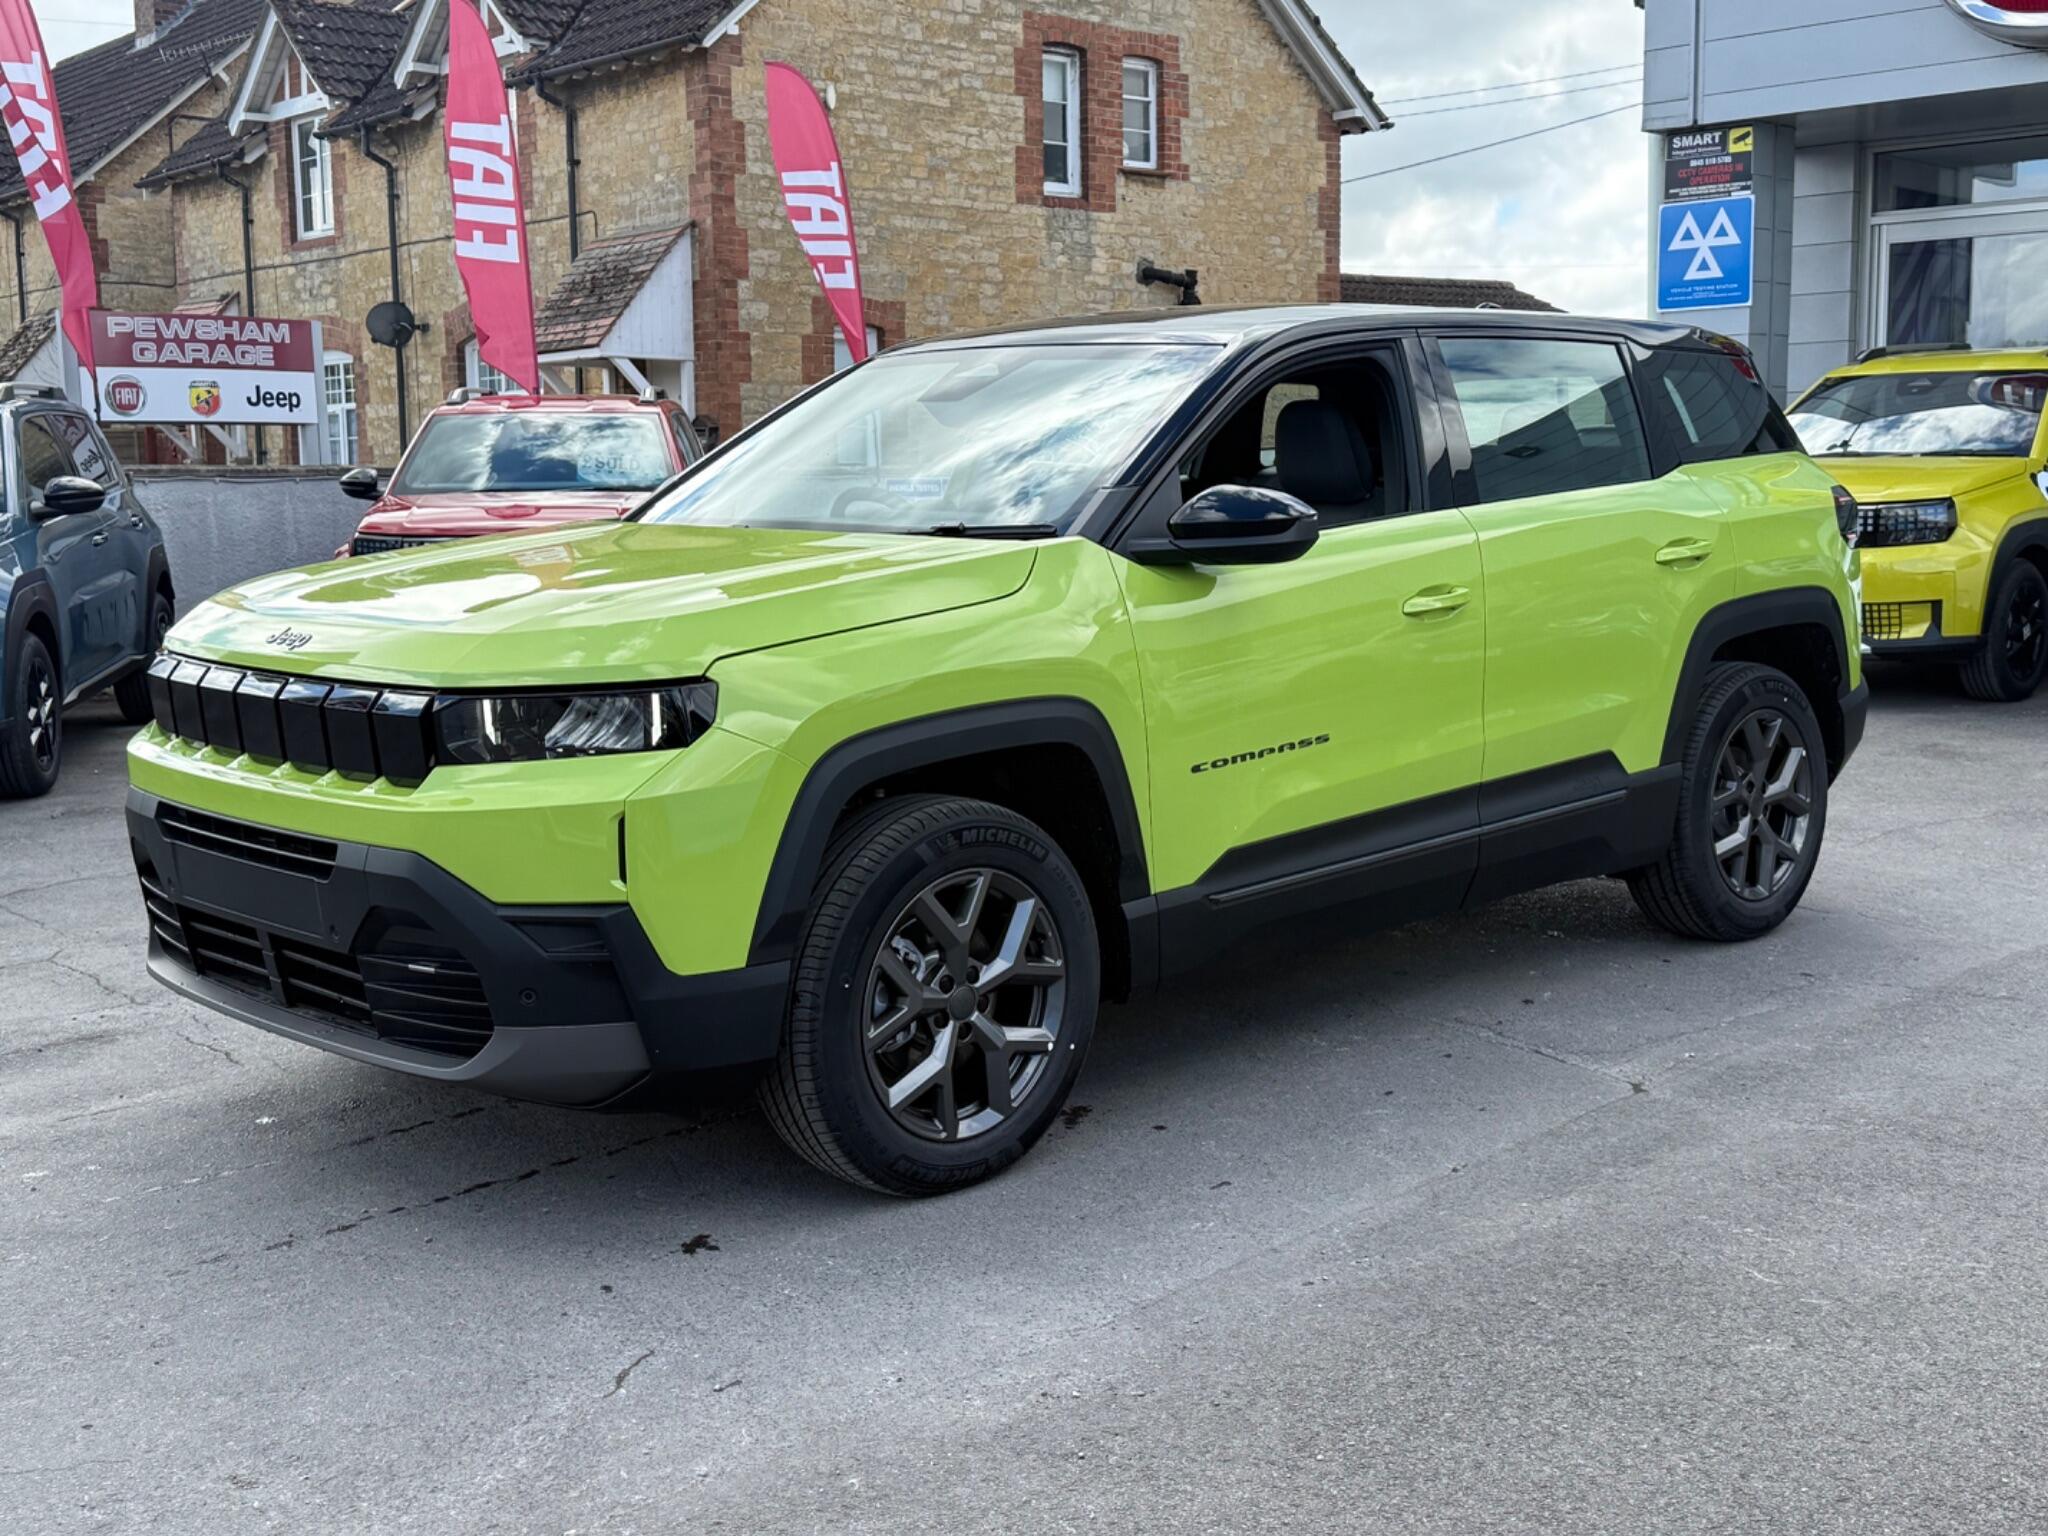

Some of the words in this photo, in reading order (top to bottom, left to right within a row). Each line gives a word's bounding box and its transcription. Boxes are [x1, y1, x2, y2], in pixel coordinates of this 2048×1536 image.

[1672, 132, 1722, 149] SMART
[106, 316, 290, 343] PEWSHAM
[132, 341, 275, 366] GARAGE
[115, 388, 139, 405] FIAT
[247, 385, 301, 412] Jeep
[265, 627, 313, 651] Jeep
[1190, 733, 1330, 774] COMPASS
[962, 829, 1047, 860] MICHELIN
